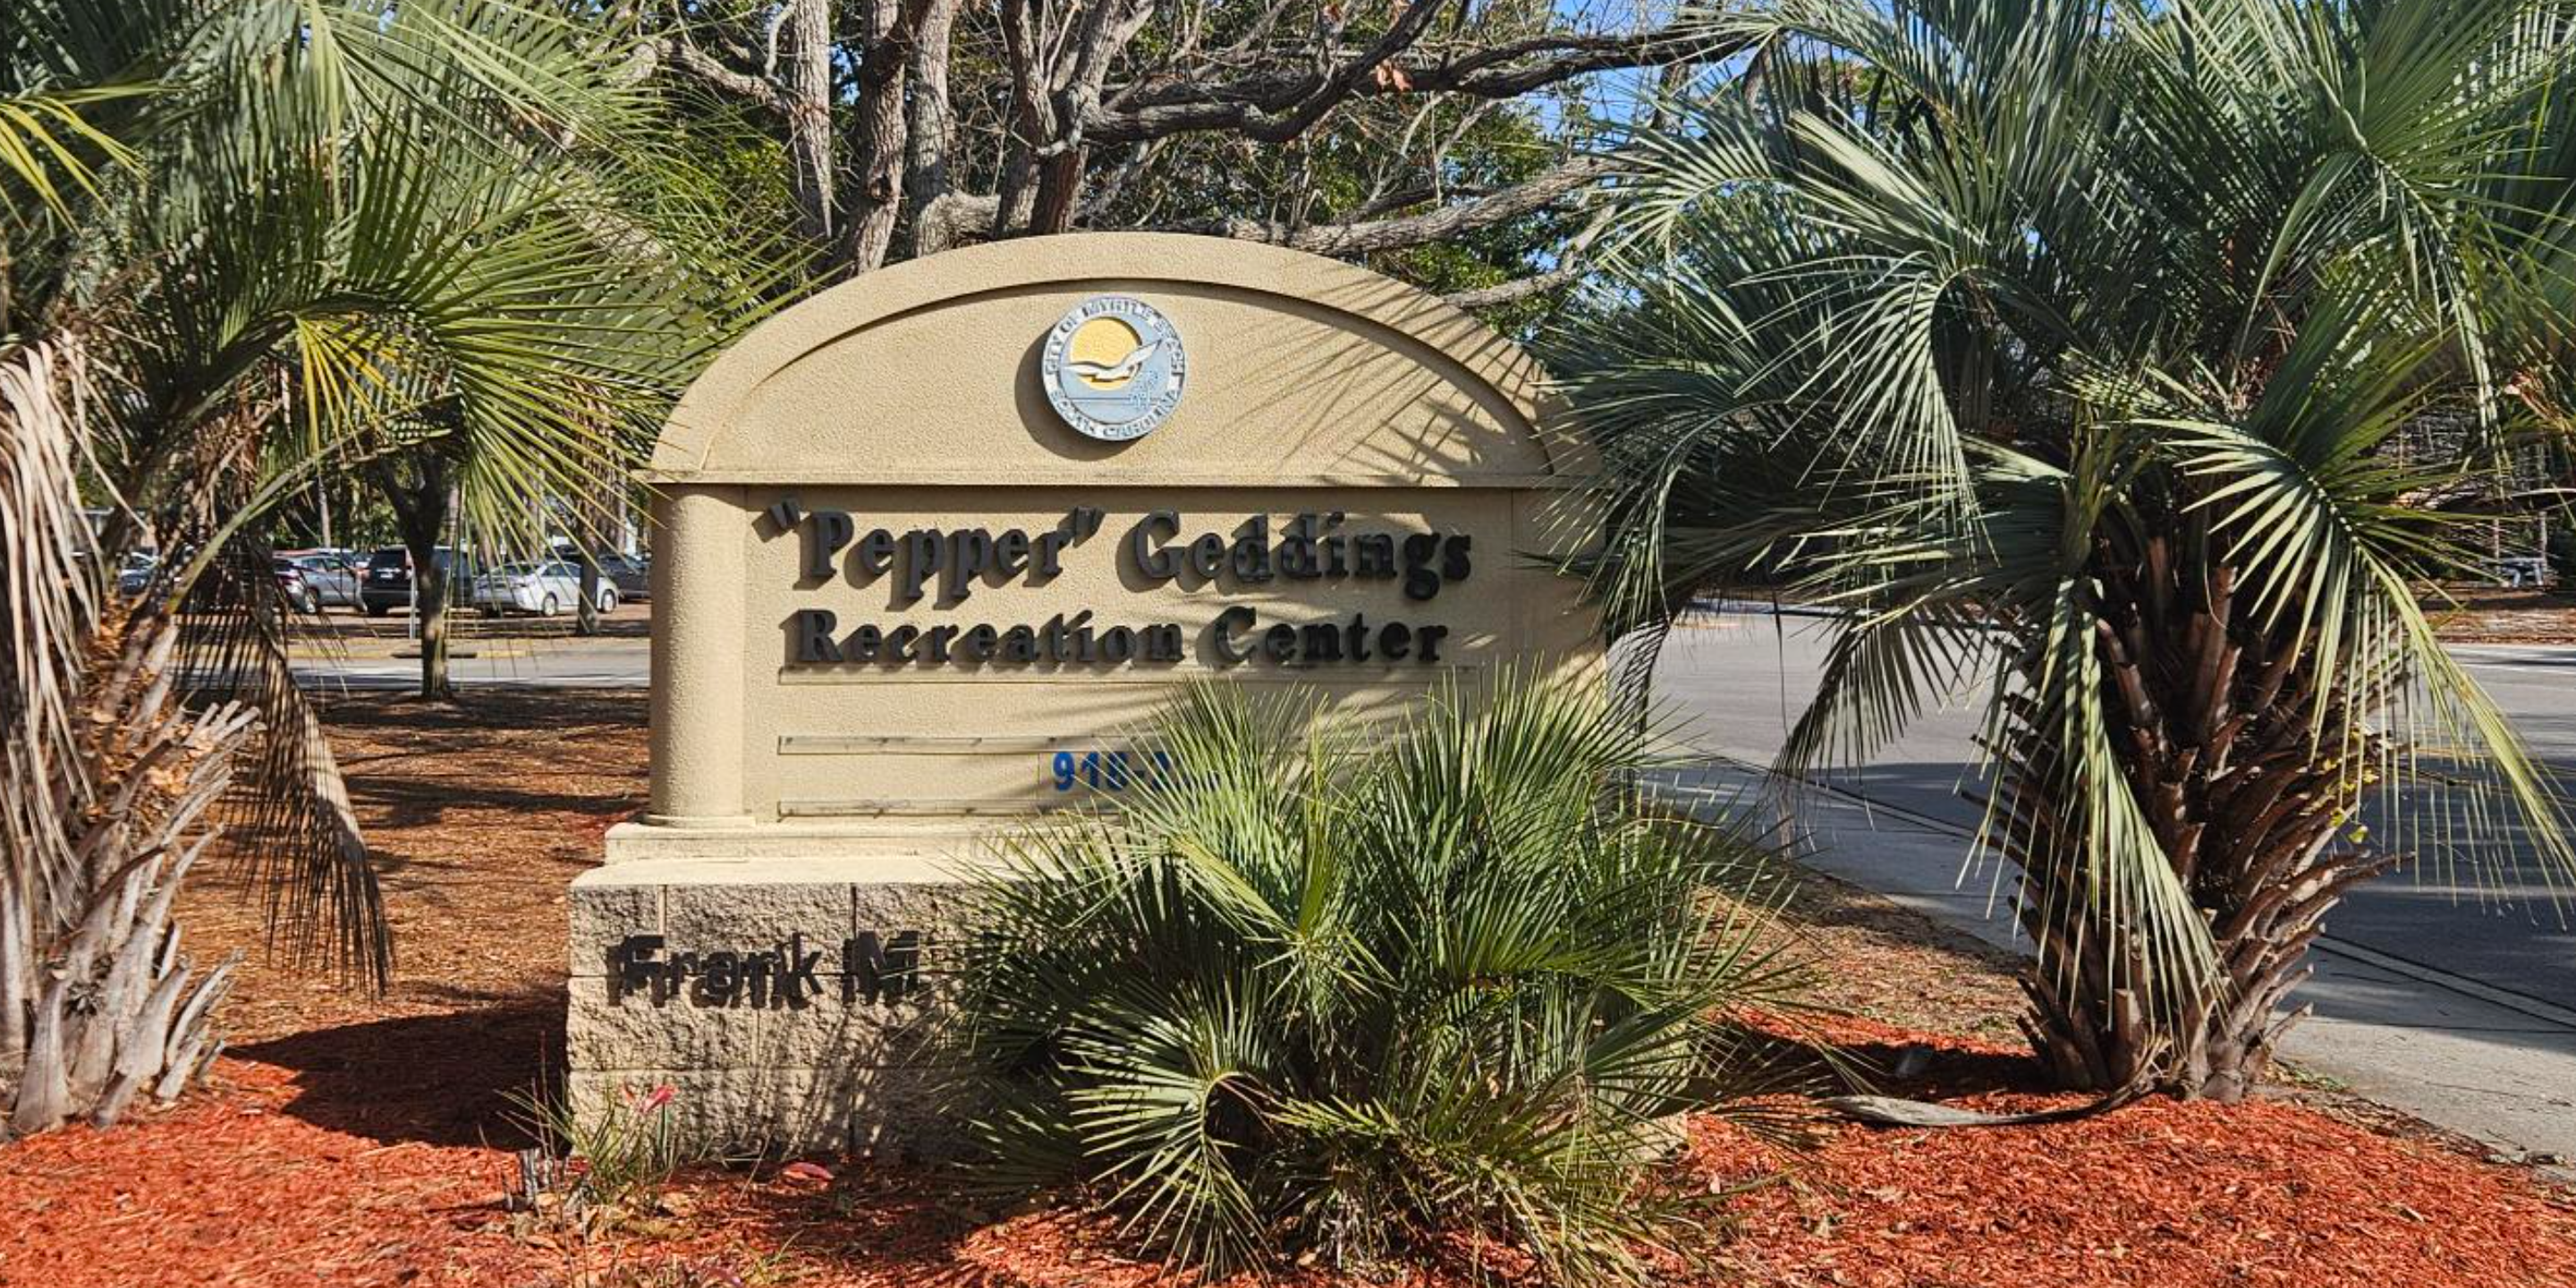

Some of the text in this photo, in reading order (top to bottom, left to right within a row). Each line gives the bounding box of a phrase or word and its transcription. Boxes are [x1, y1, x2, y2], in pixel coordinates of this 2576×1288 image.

[1133, 509, 1472, 601] Geddings
[801, 606, 1449, 663] Recreation Center
[622, 932, 823, 996] Frank
